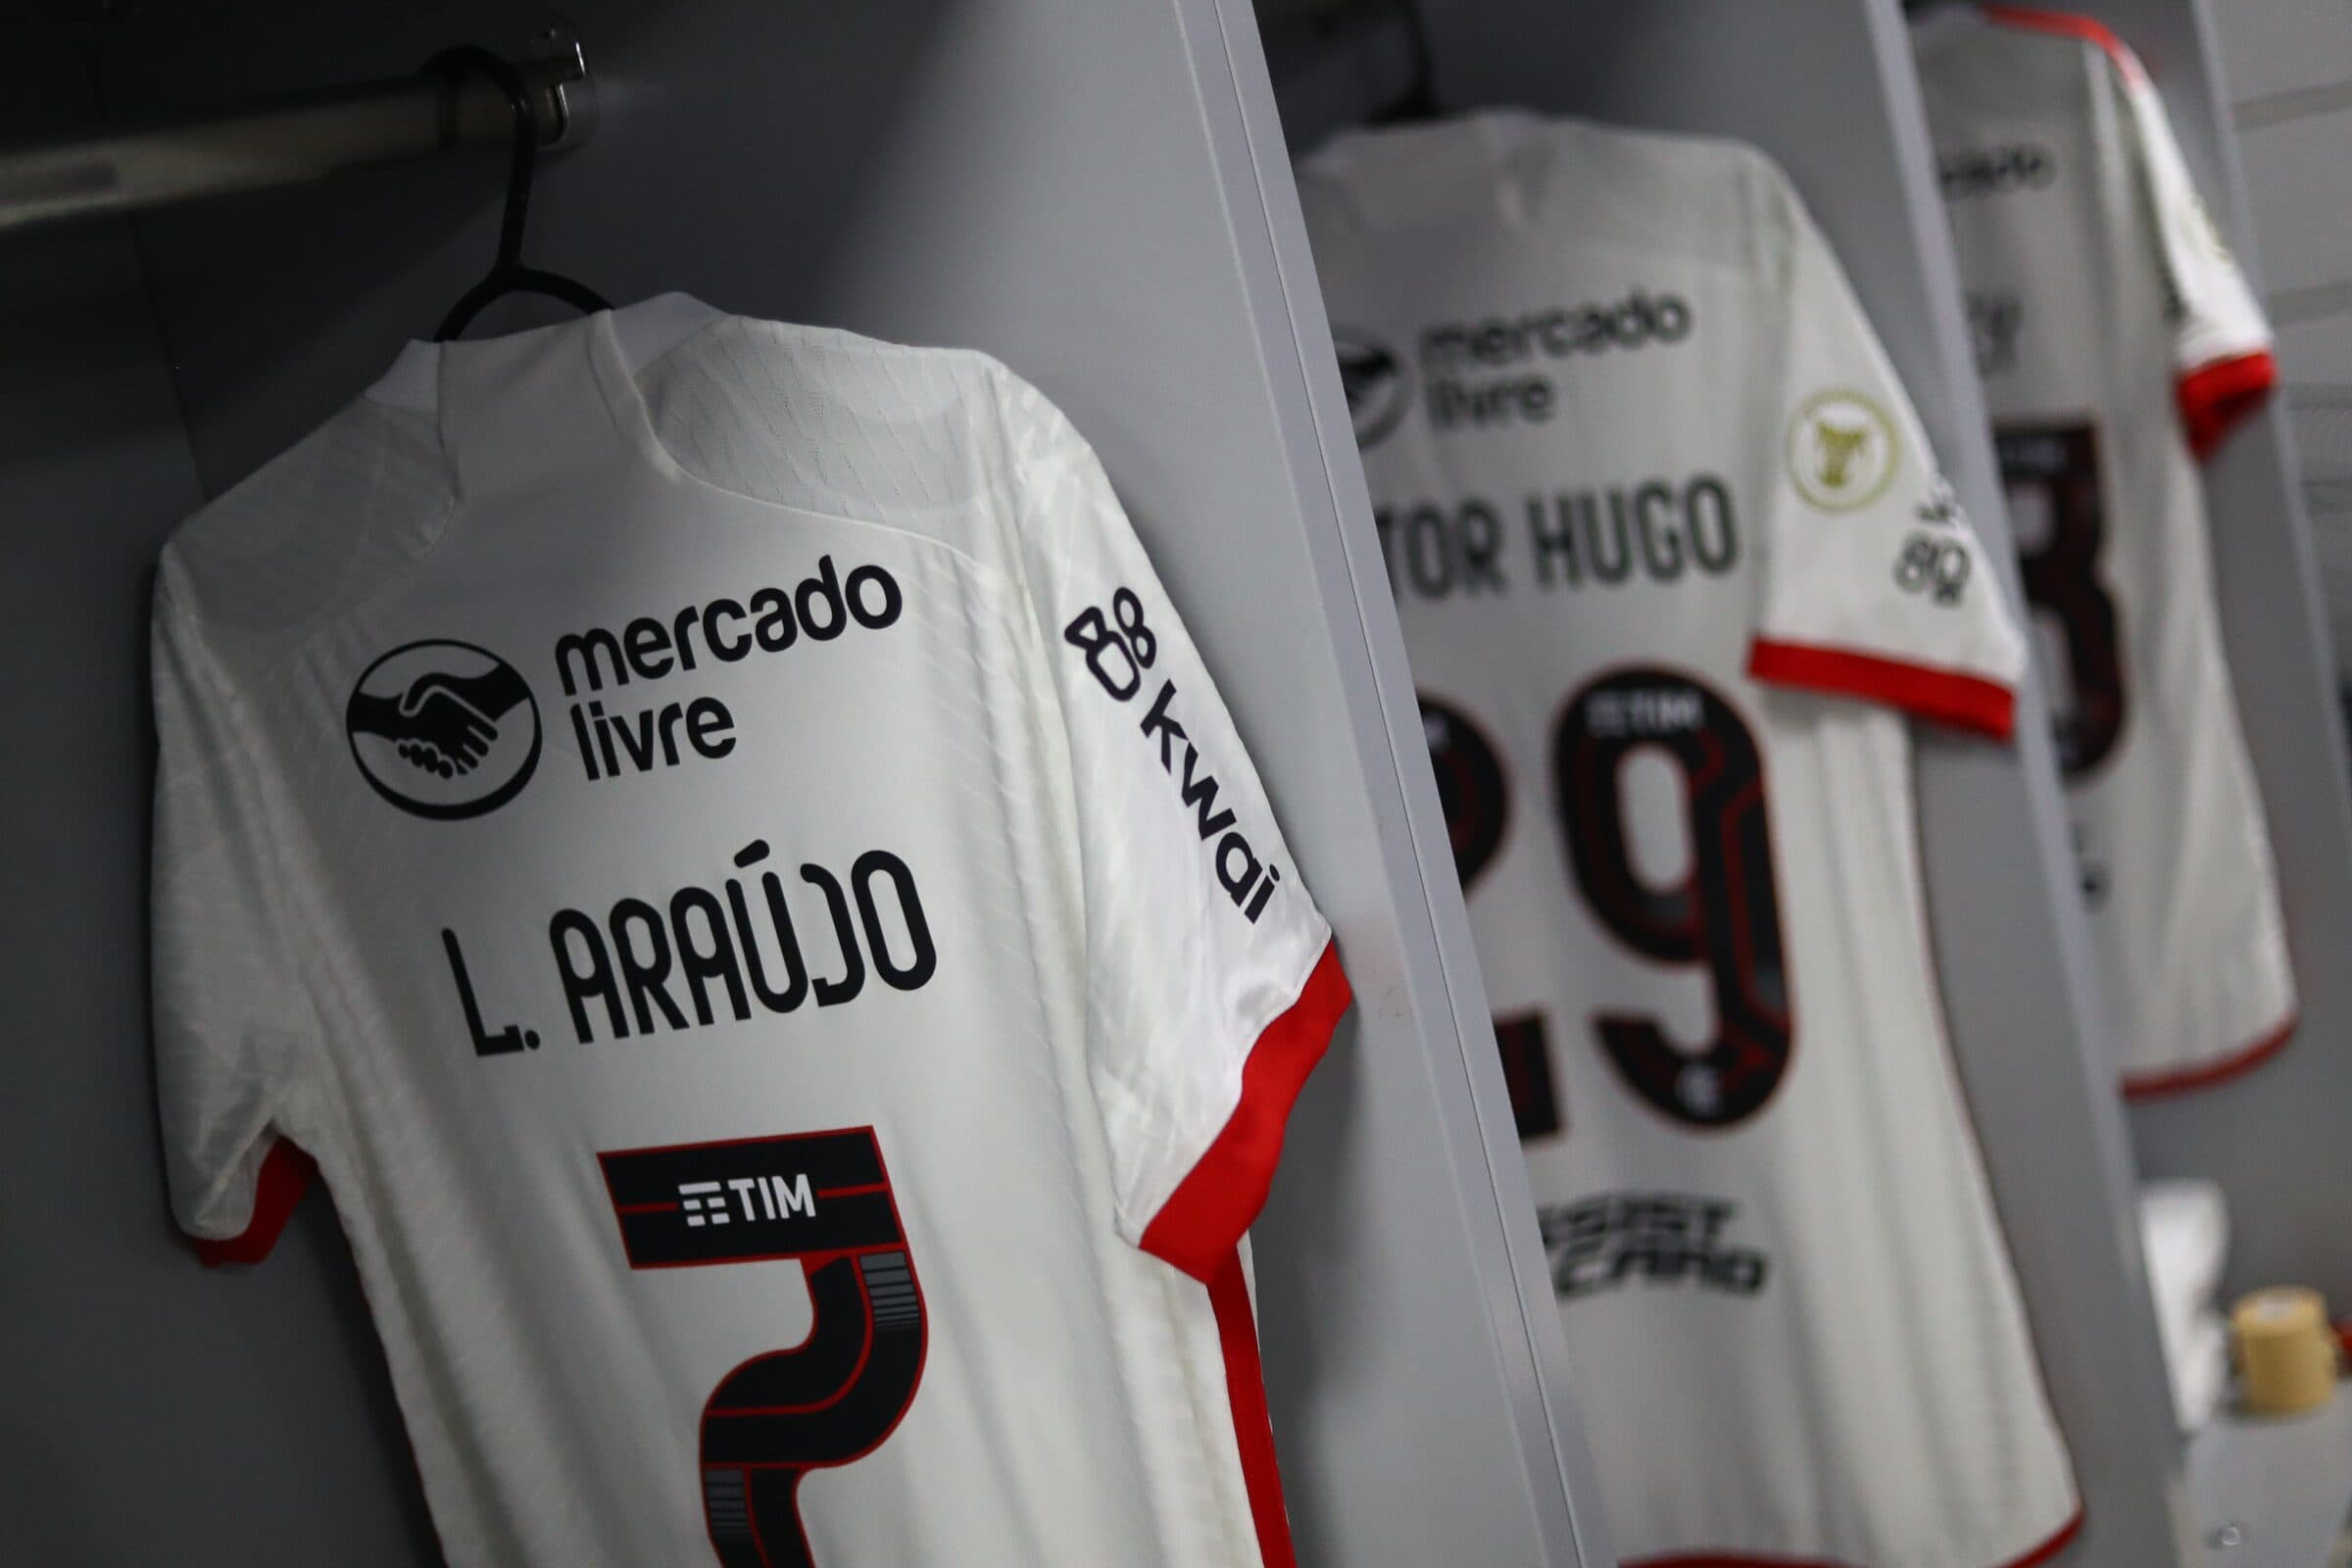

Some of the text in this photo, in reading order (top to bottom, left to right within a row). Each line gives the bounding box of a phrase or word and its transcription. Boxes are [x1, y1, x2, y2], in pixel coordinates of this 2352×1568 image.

[1419, 285, 1693, 367] mercado
[1426, 373, 1555, 429] livre
[1524, 473, 1739, 592] HUGO
[555, 555, 903, 697] mercado
[569, 697, 736, 781] livre
[441, 838, 937, 1056] L. ARAÚJO
[596, 1124, 929, 1568] 7
